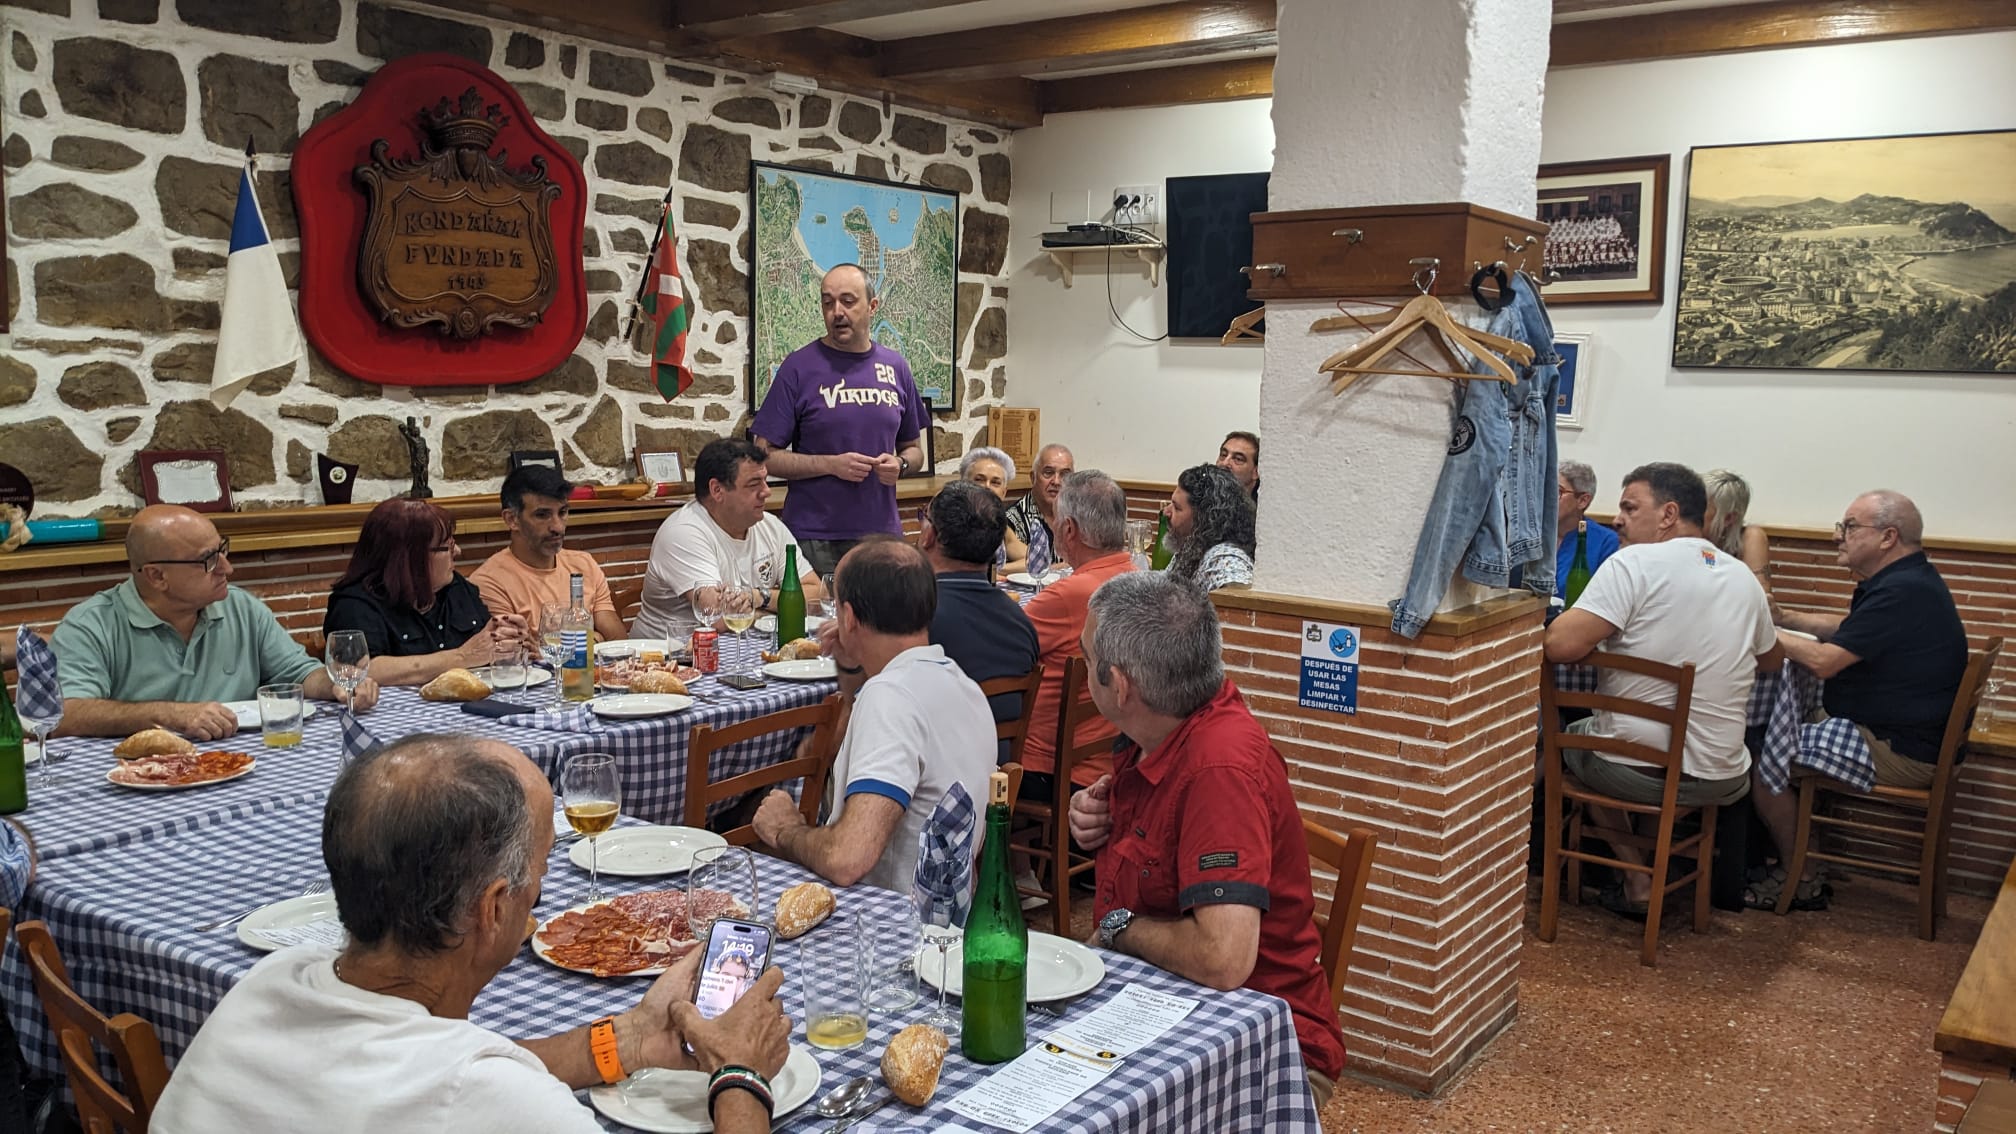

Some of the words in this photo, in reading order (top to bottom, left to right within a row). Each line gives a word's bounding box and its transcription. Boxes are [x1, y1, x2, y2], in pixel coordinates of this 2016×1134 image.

[874, 362, 897, 386] 28
[1304, 659, 1340, 671] DESPUÉS
[1342, 665, 1353, 673] DE
[1308, 669, 1330, 679] USAR
[1331, 674, 1347, 682] LAS
[1313, 681, 1340, 691] MESAS
[1307, 689, 1339, 701] LIMPIAR
[1300, 699, 1354, 714] DESINFECTAR
